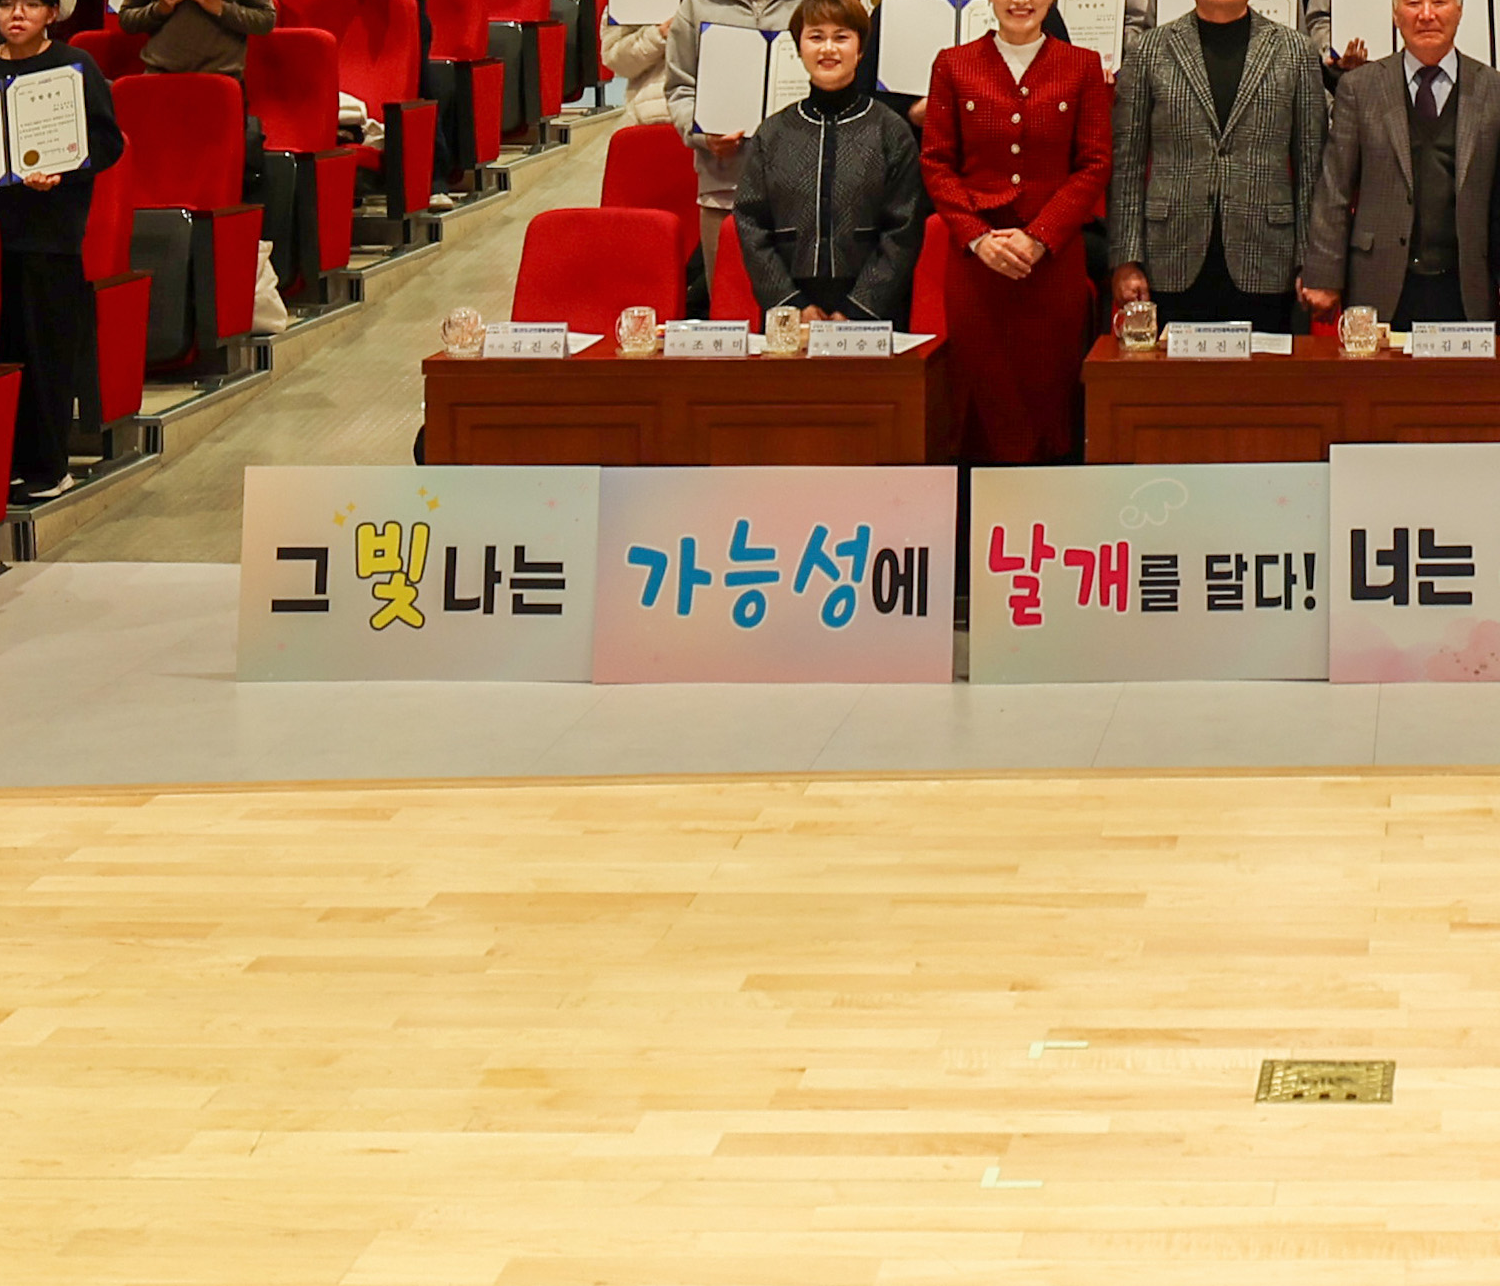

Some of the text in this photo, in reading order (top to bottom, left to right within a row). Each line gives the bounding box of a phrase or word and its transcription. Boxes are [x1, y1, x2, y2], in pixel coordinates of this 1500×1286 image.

[271, 521, 566, 630] 그 빛나는
[627, 518, 930, 630] 가능성에
[988, 522, 1316, 627] 날개를 달다!
[1350, 527, 1475, 606] 너는
